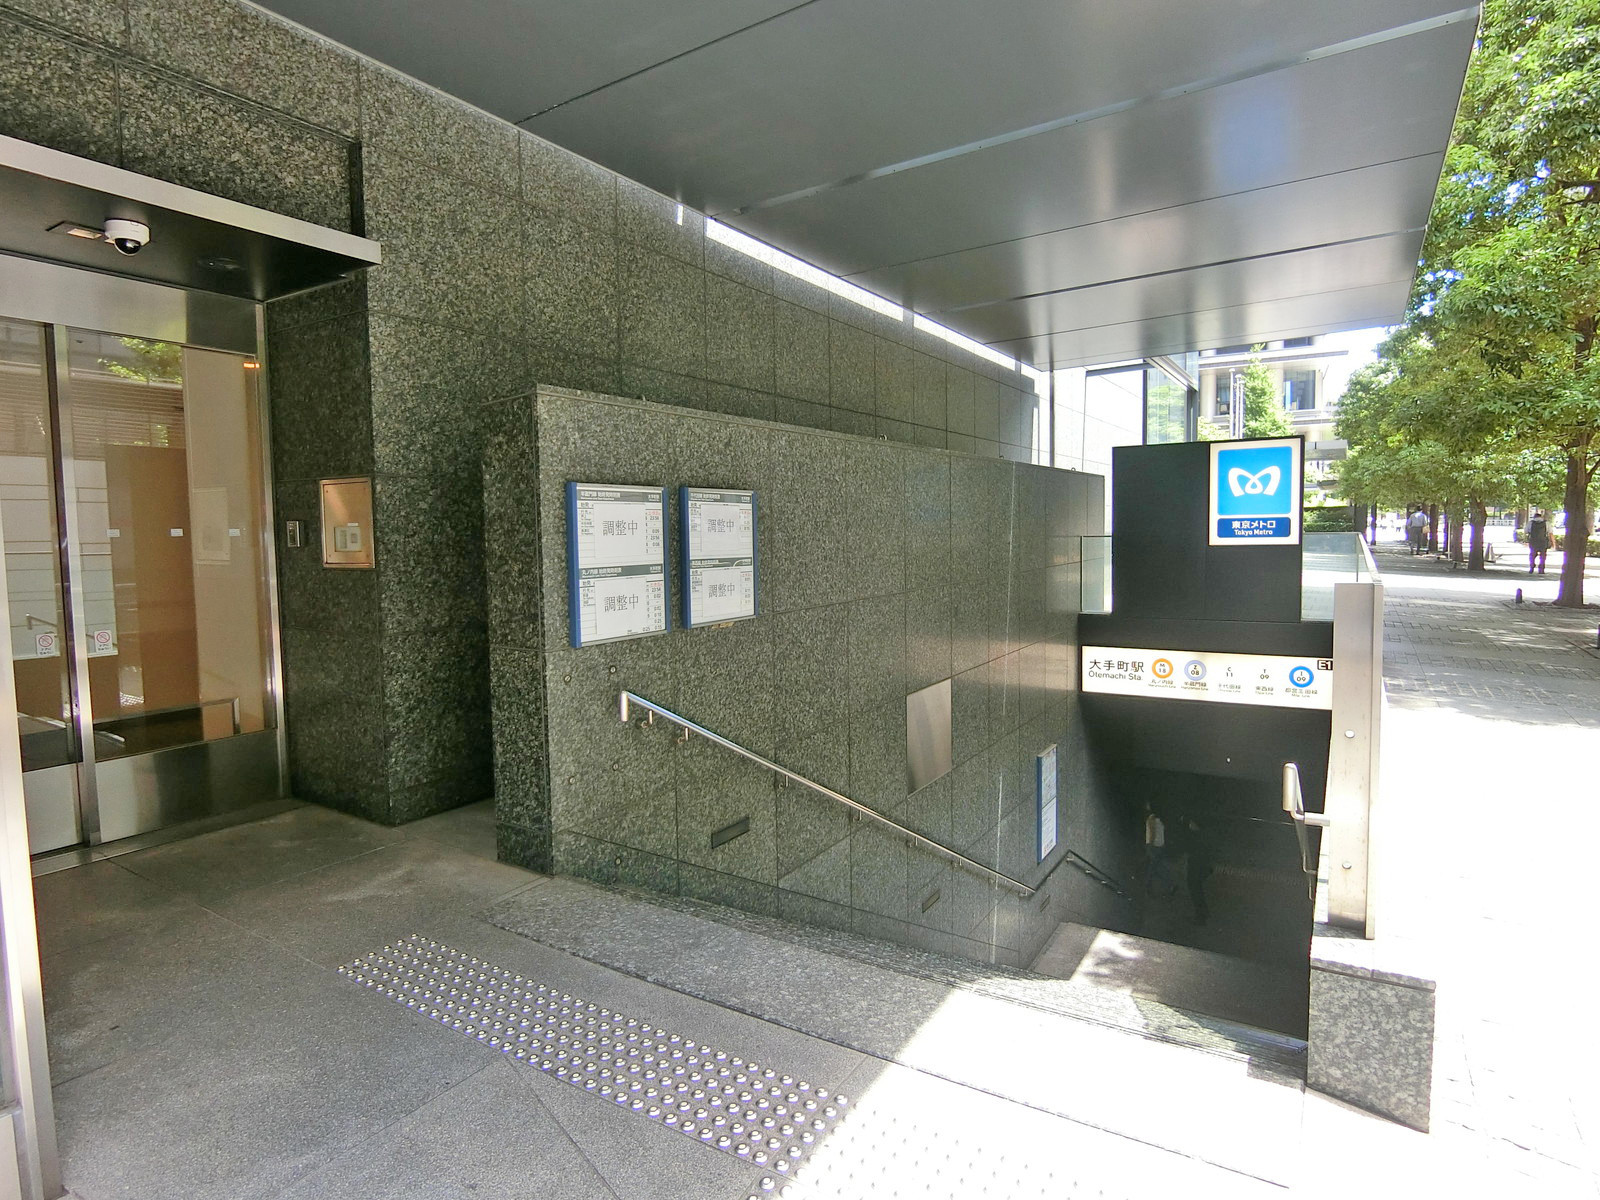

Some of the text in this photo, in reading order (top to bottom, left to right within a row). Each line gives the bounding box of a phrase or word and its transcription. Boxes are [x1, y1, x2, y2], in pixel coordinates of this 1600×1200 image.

[603, 519, 638, 536] 調整中
[707, 518, 735, 533] 調整中
[1231, 520, 1276, 529] 東京メトロ
[707, 582, 736, 599] 調整中
[603, 593, 639, 613] 調整中
[1089, 659, 1144, 673] 大手町駅
[1319, 660, 1332, 670] E1
[1088, 670, 1126, 679] Otemachi
